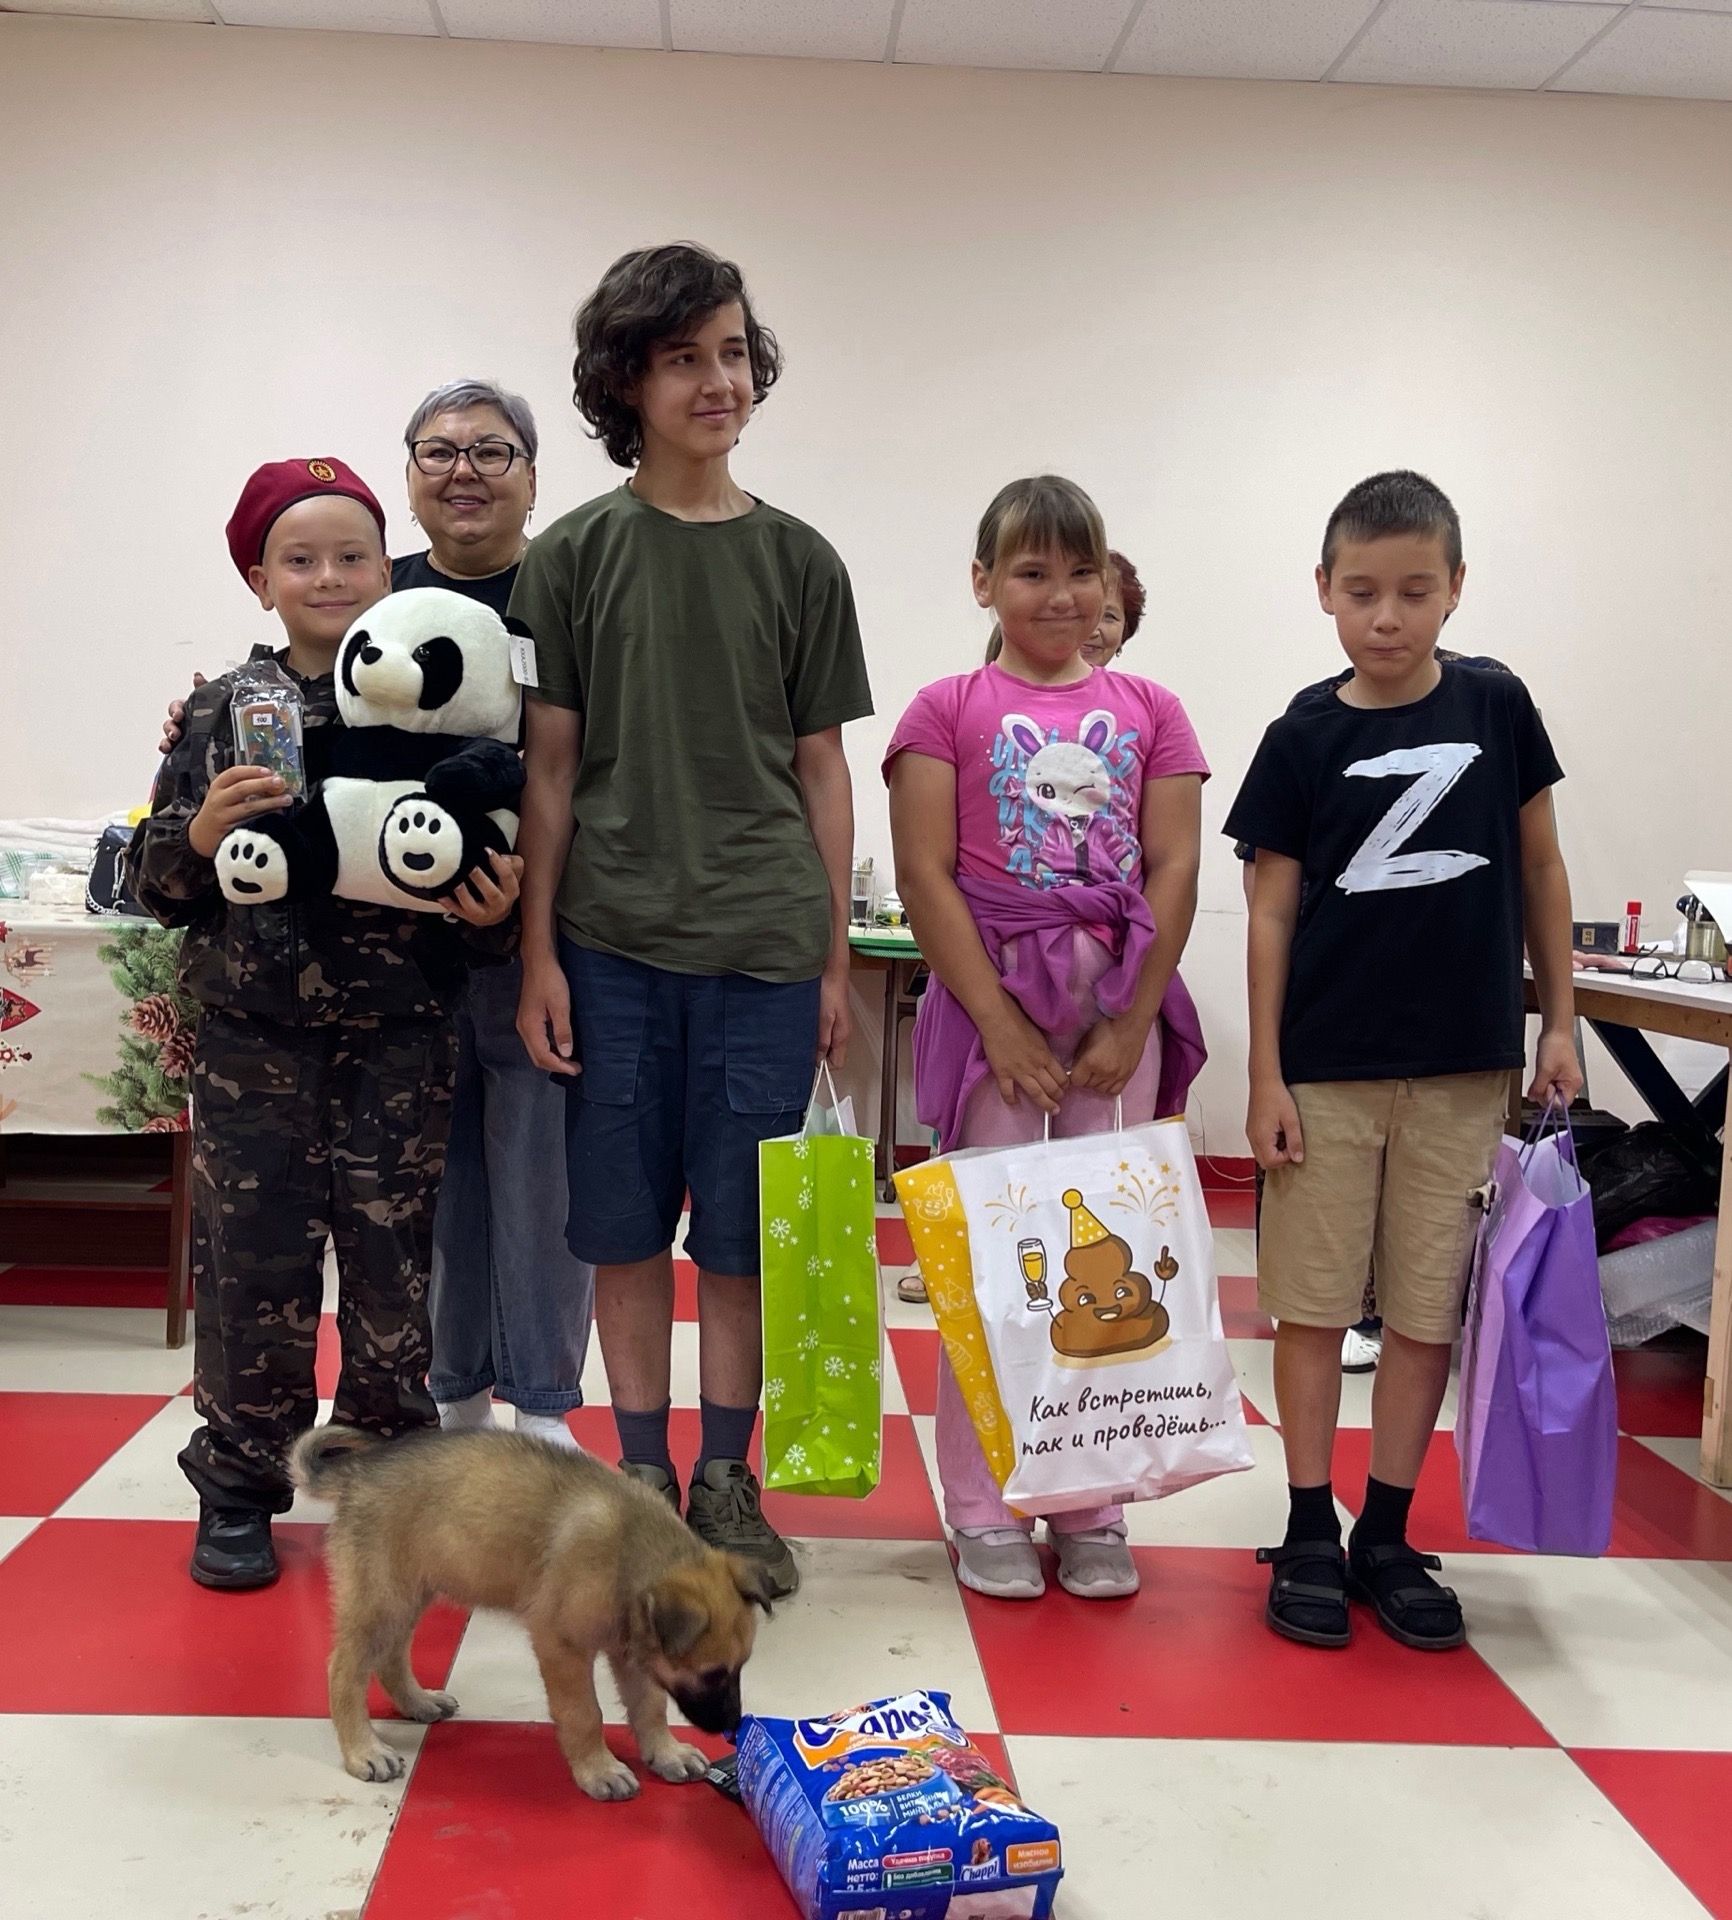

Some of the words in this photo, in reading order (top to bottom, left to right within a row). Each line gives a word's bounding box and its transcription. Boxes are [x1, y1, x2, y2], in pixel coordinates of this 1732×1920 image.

[1335, 742, 1490, 895] Z
[1029, 1395, 1069, 1422] Как
[1077, 1381, 1212, 1413] встретишь,
[1071, 1433, 1084, 1448] и
[1093, 1414, 1227, 1451] проведёшь...
[896, 1790, 923, 1803] БЕЛКИ
[839, 1799, 888, 1816] 100%
[847, 1858, 880, 1871] Масса
[846, 1872, 879, 1884] нетто:
